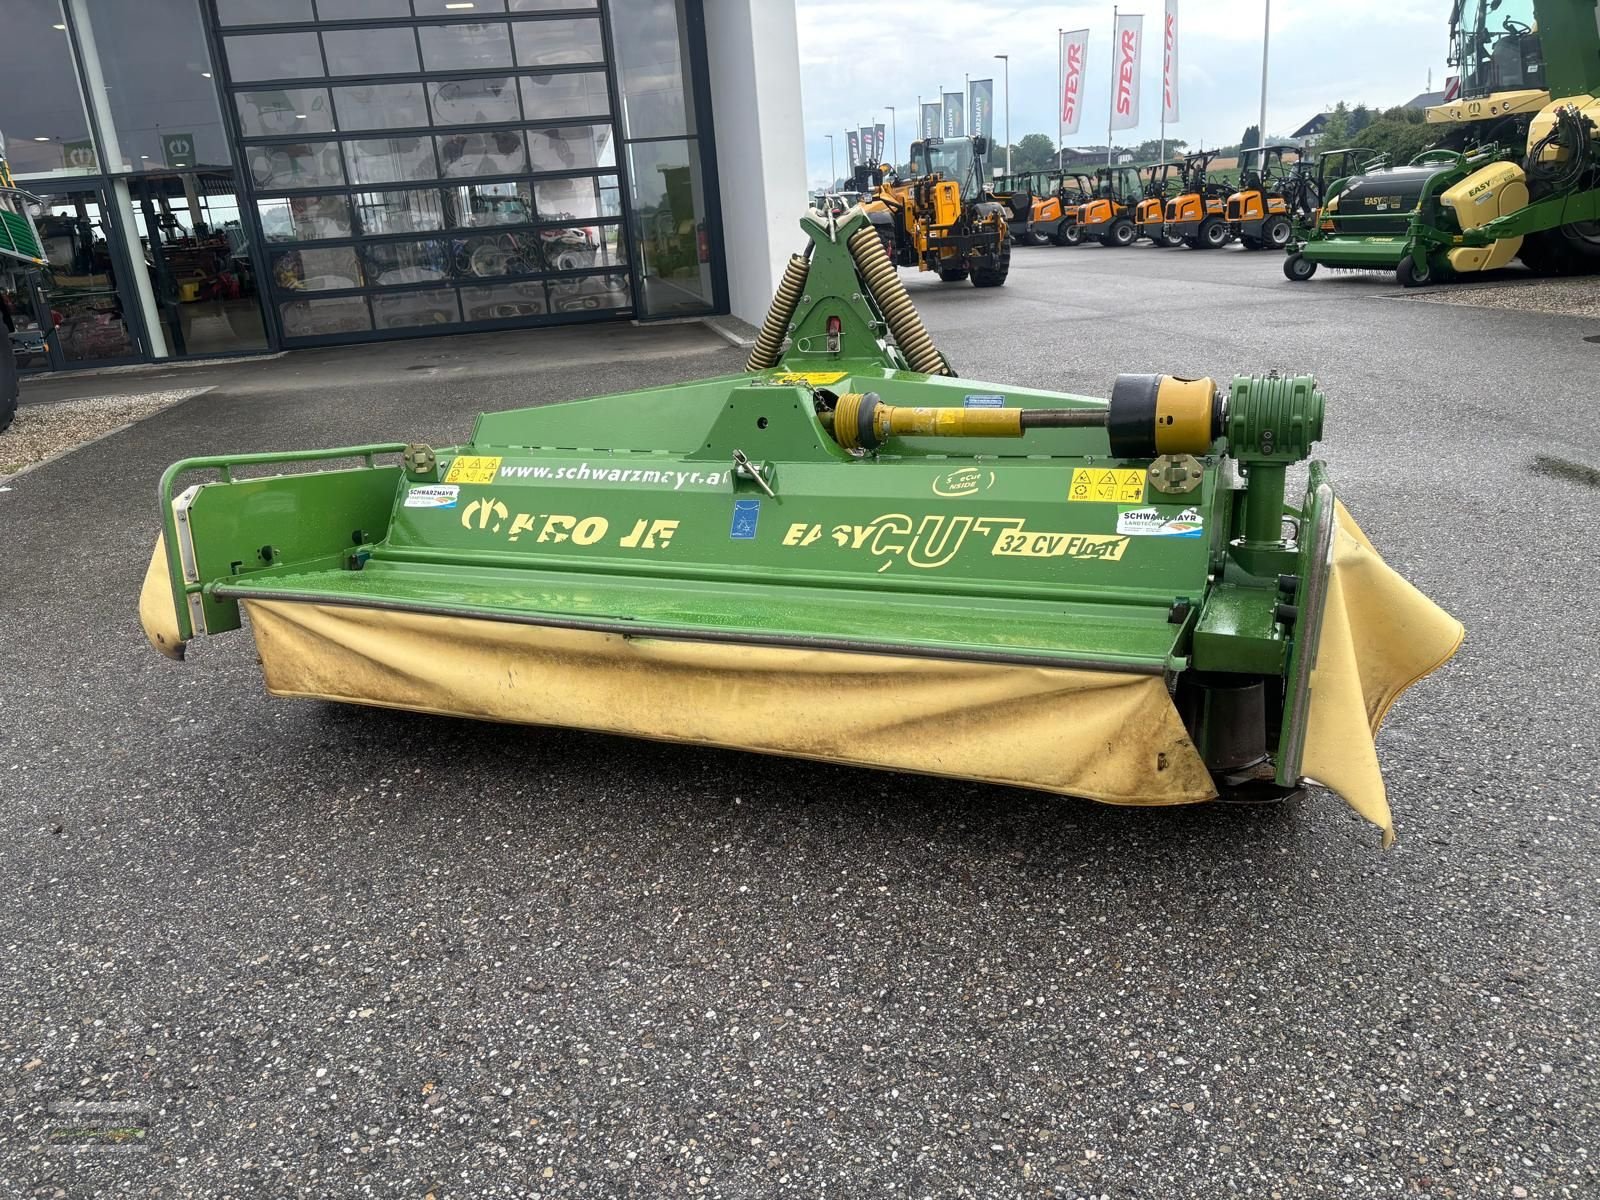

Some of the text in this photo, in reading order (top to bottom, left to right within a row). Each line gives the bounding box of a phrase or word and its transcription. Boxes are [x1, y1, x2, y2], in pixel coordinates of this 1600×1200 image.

[1117, 29, 1135, 116] STEYR
[1062, 43, 1081, 124] STEYR
[949, 481, 977, 490] NSIDE
[1124, 512, 1197, 522] SCHWAAYR
[1000, 535, 1027, 553] 32
[1031, 536, 1063, 554] CV
